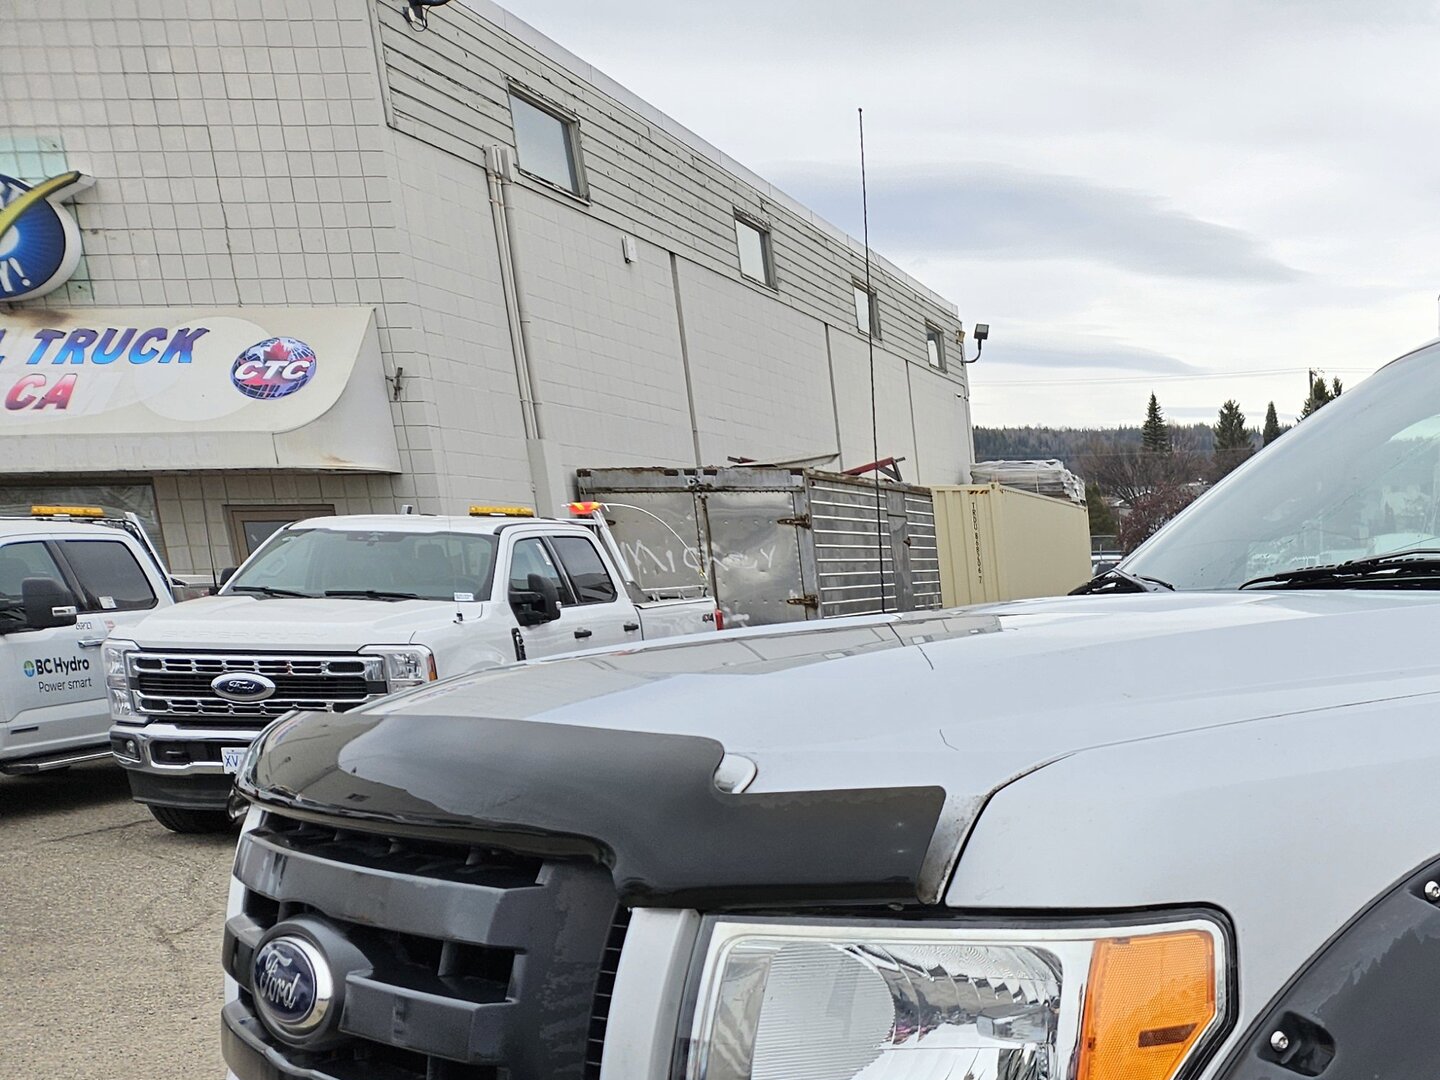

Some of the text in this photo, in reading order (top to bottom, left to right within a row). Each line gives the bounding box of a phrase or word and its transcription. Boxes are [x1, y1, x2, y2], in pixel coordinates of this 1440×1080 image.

[26, 327, 210, 365] TRUCK
[235, 360, 311, 380] CTC
[36, 656, 90, 676] BC Hydro
[38, 678, 92, 693] Power smart
[260, 949, 301, 1009] Ford
